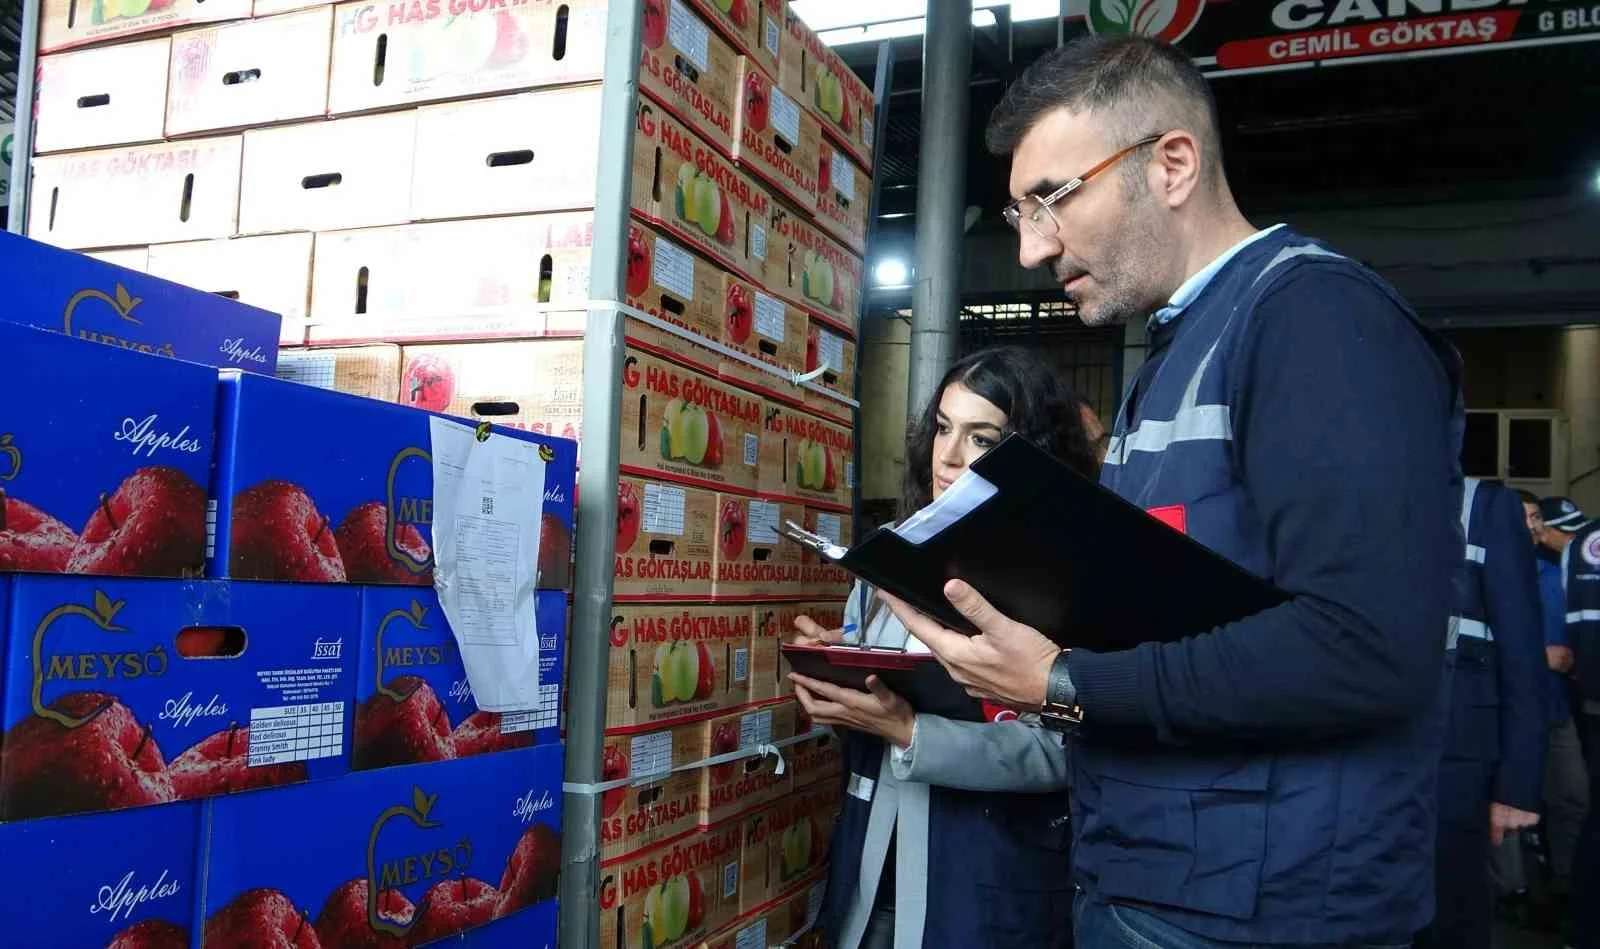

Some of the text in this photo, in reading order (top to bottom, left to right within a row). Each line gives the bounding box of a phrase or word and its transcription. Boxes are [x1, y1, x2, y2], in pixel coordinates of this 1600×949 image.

[388, 0, 441, 26] HAS
[1539, 11, 1555, 31] G
[1268, 16, 1498, 59] CEMİL GÖKTAŞ
[640, 45, 660, 78] AS
[661, 119, 692, 162] HAS
[695, 147, 768, 216] GÖKTAŞLAR
[219, 338, 267, 364] Apples
[646, 366, 679, 398] HAS
[682, 376, 761, 426] GÖKTAŞLAR
[114, 414, 201, 457] Apples
[785, 415, 808, 438] HAS
[615, 554, 711, 583] AS GÖKTAŞLAR
[719, 560, 799, 584] HAS GÖKTAŞLAR
[634, 618, 666, 643] HAS
[671, 611, 750, 641] GÖKTAŞLAR
[160, 691, 229, 728] Apples
[513, 790, 554, 823] Apples
[601, 795, 699, 843] AS GÖKTAŞLAR
[623, 860, 657, 898] HAS
[661, 828, 743, 881] GÖKTAŞLAR
[90, 870, 181, 922] Apples
